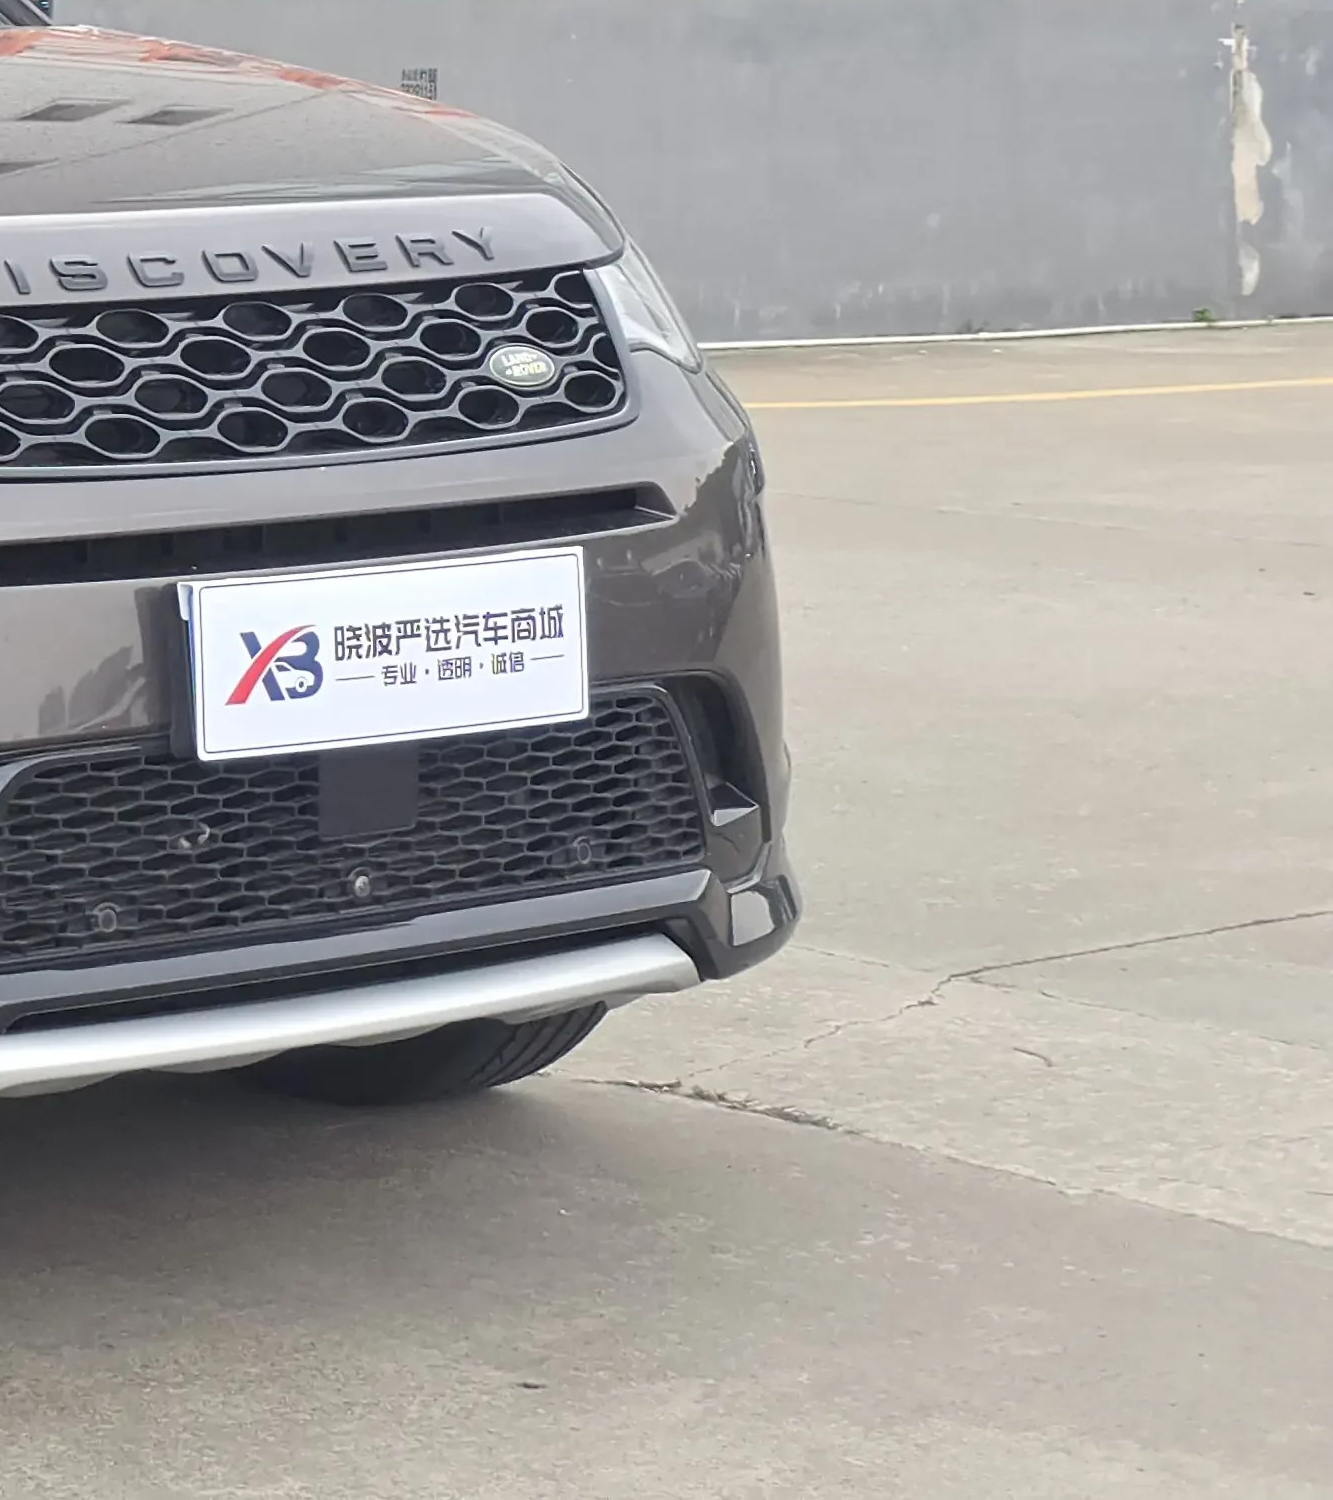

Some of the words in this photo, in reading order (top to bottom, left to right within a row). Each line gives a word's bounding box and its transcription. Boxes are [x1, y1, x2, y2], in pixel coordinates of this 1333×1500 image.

[333, 603, 565, 662] 晓波严选汽车商城
